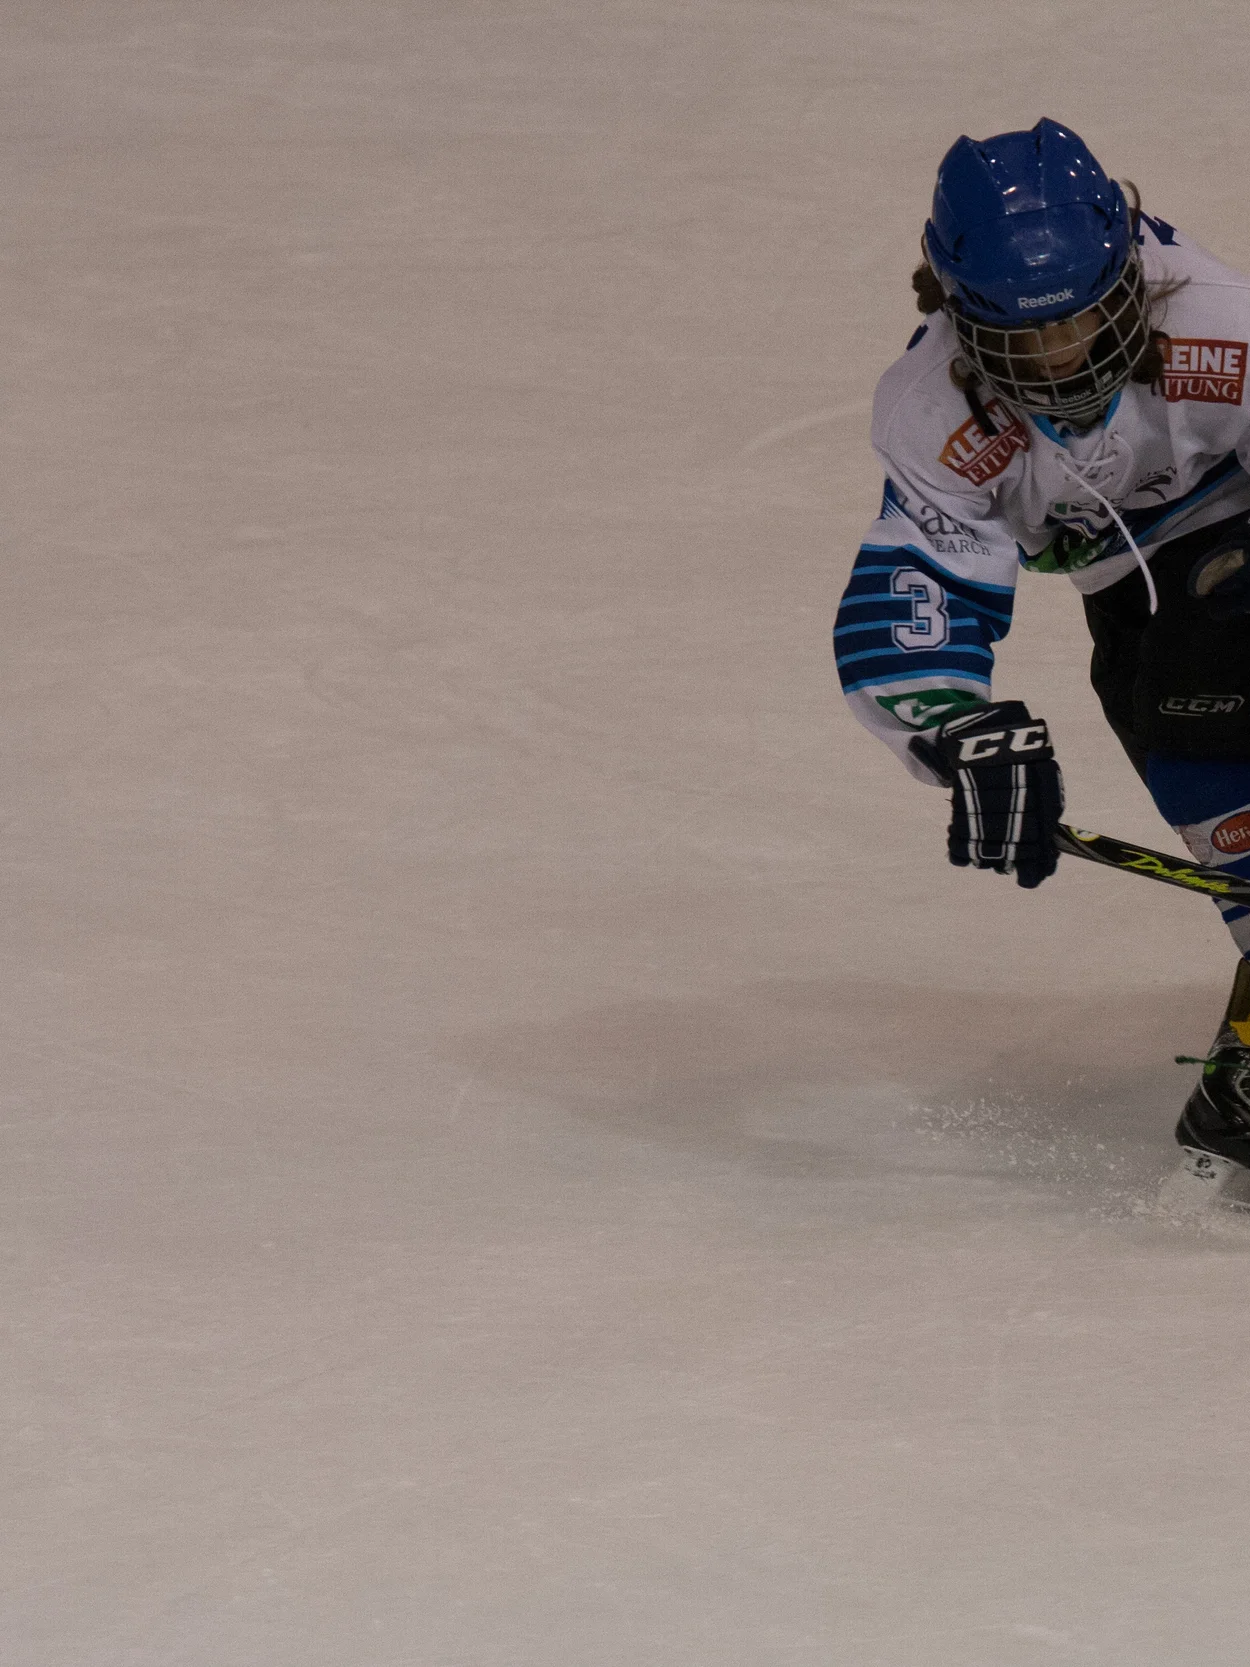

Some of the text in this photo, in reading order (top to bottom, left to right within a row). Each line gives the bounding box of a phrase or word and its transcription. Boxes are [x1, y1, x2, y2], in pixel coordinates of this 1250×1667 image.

[1017, 287, 1076, 310] Reebok
[889, 565, 951, 654] 3
[1164, 696, 1237, 714] CCM
[957, 724, 1053, 763] CC
